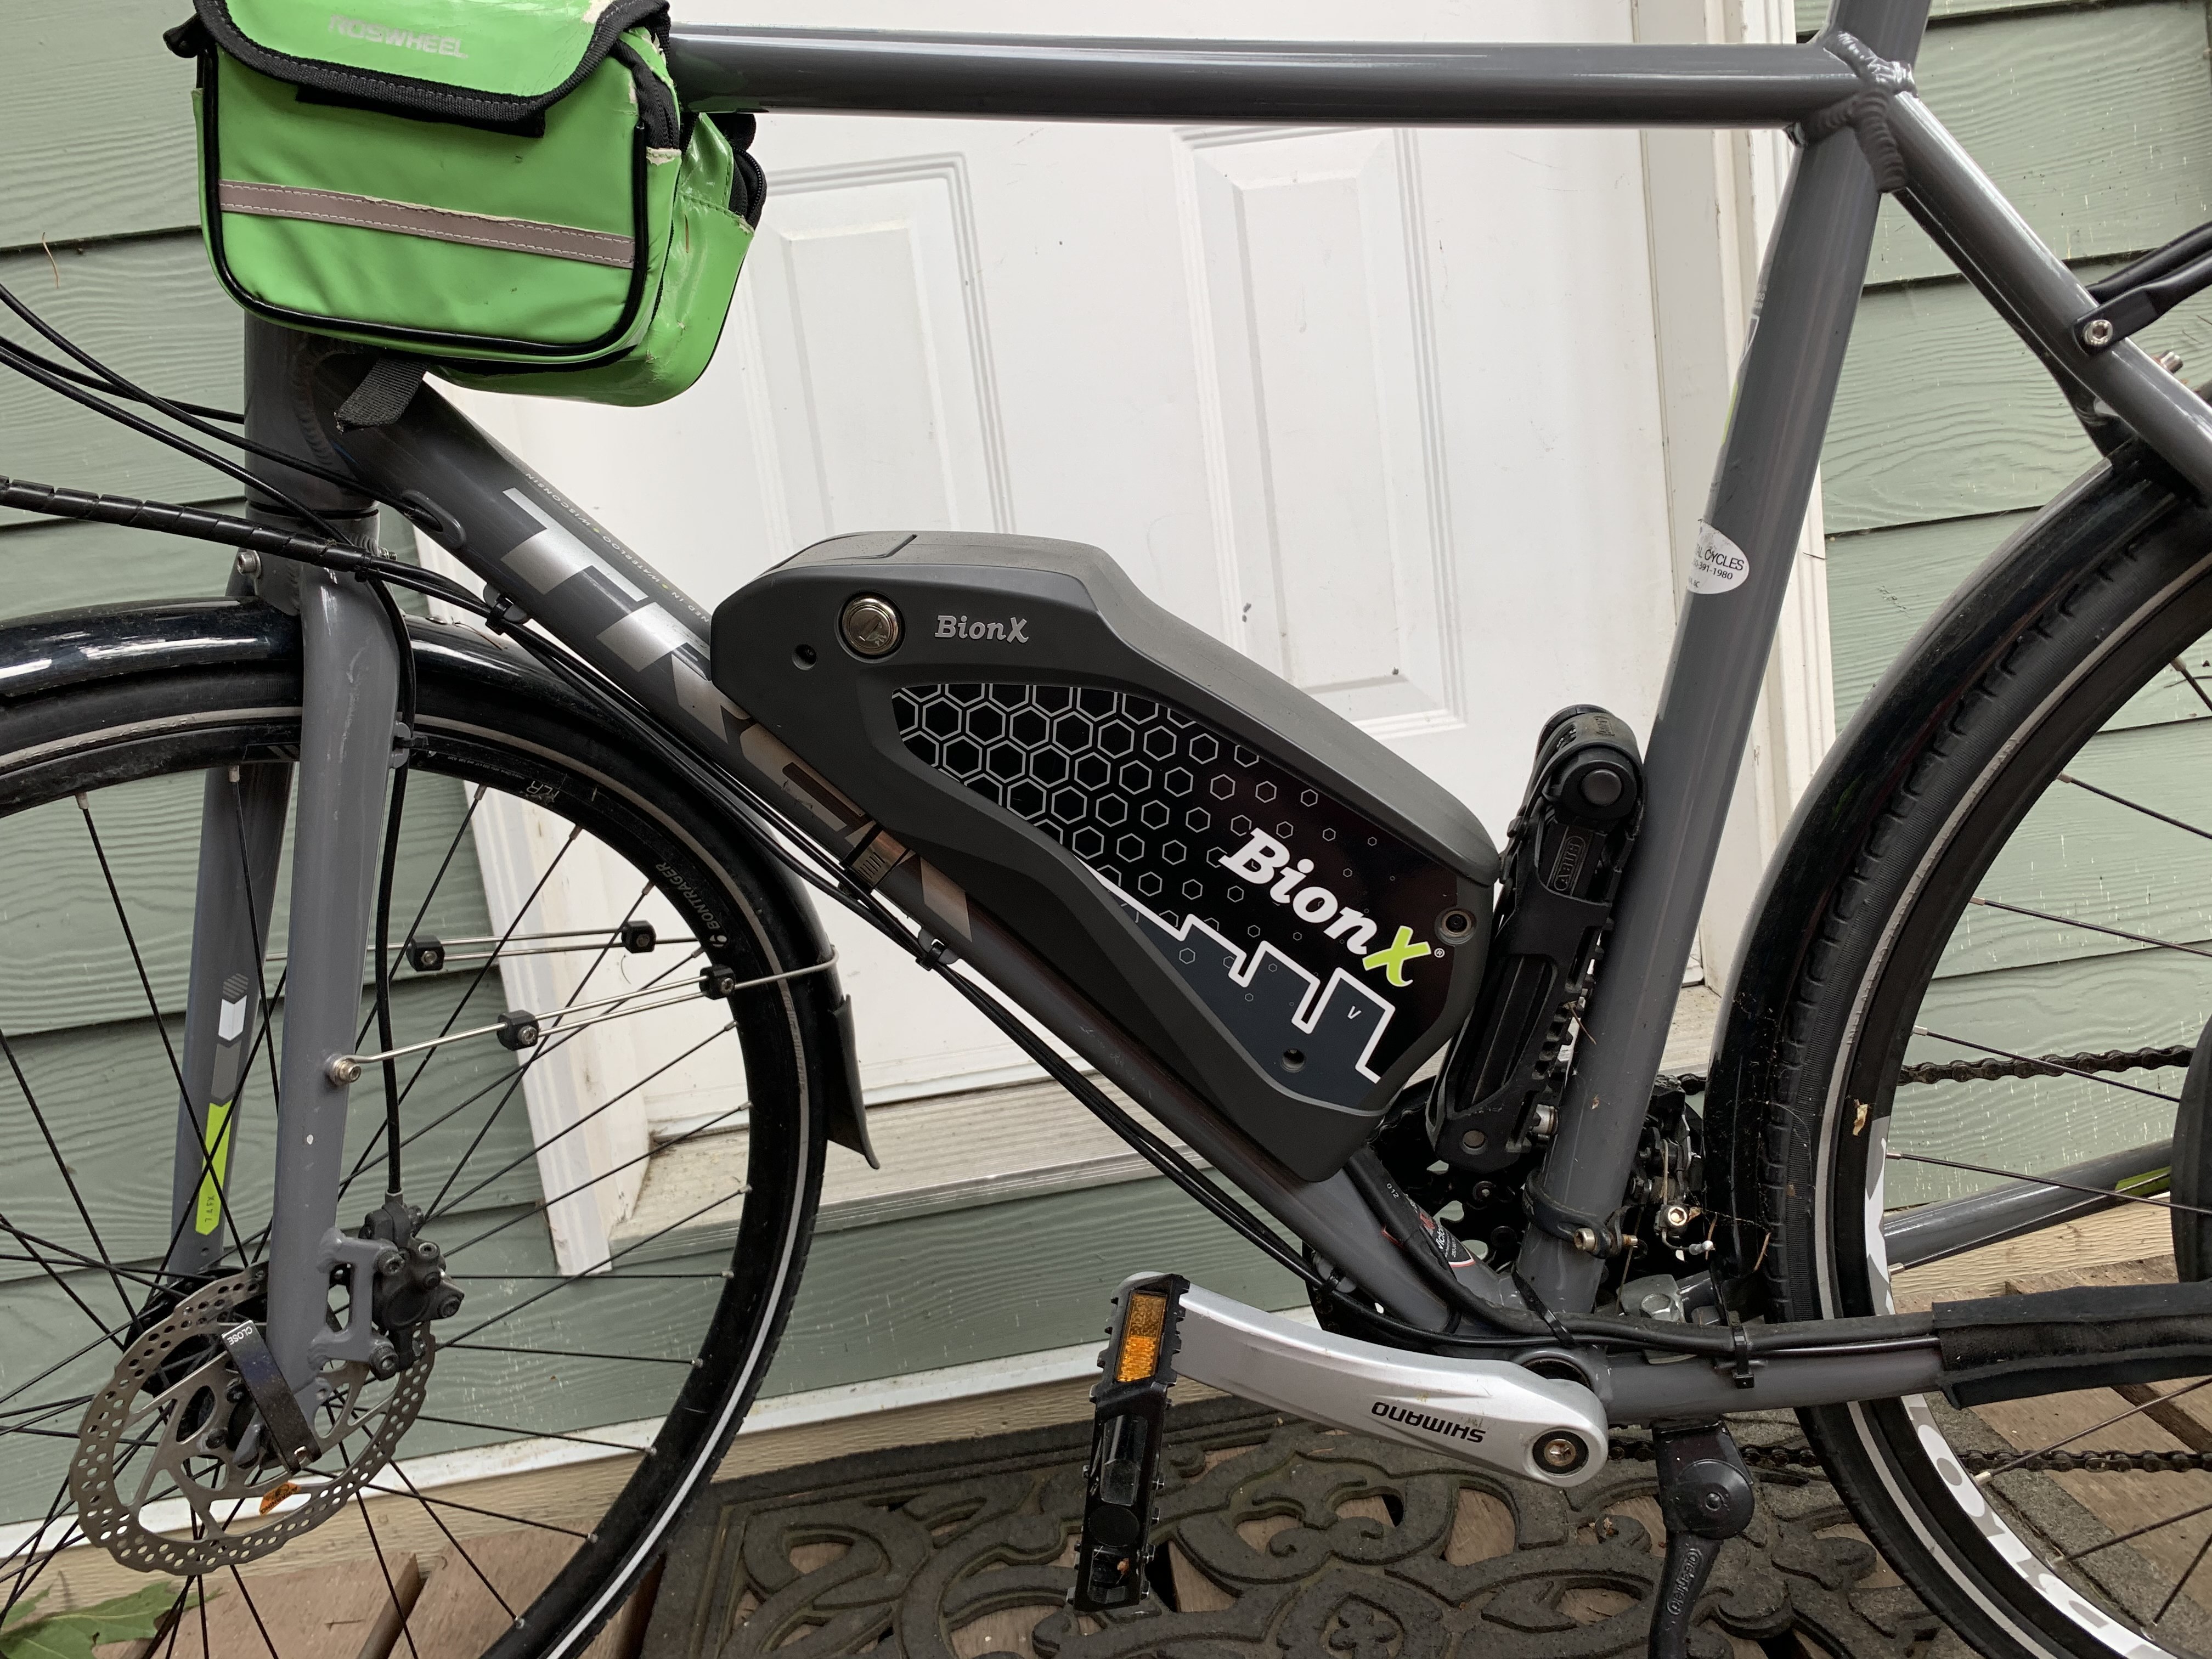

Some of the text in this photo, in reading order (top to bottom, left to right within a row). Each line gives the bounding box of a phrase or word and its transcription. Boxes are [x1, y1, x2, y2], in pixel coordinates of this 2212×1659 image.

[525, 472, 592, 527] WISCONSIN
[603, 535, 661, 583] WATERLOO
[1704, 549, 1745, 571] CYCLES
[671, 591, 684, 602] IN
[934, 614, 1029, 644] BionX
[655, 861, 721, 930] BONTRAGER
[1218, 827, 1432, 988] BionX
[227, 1326, 253, 1346] CLOSE
[1371, 1401, 1486, 1443] SHIMANO
